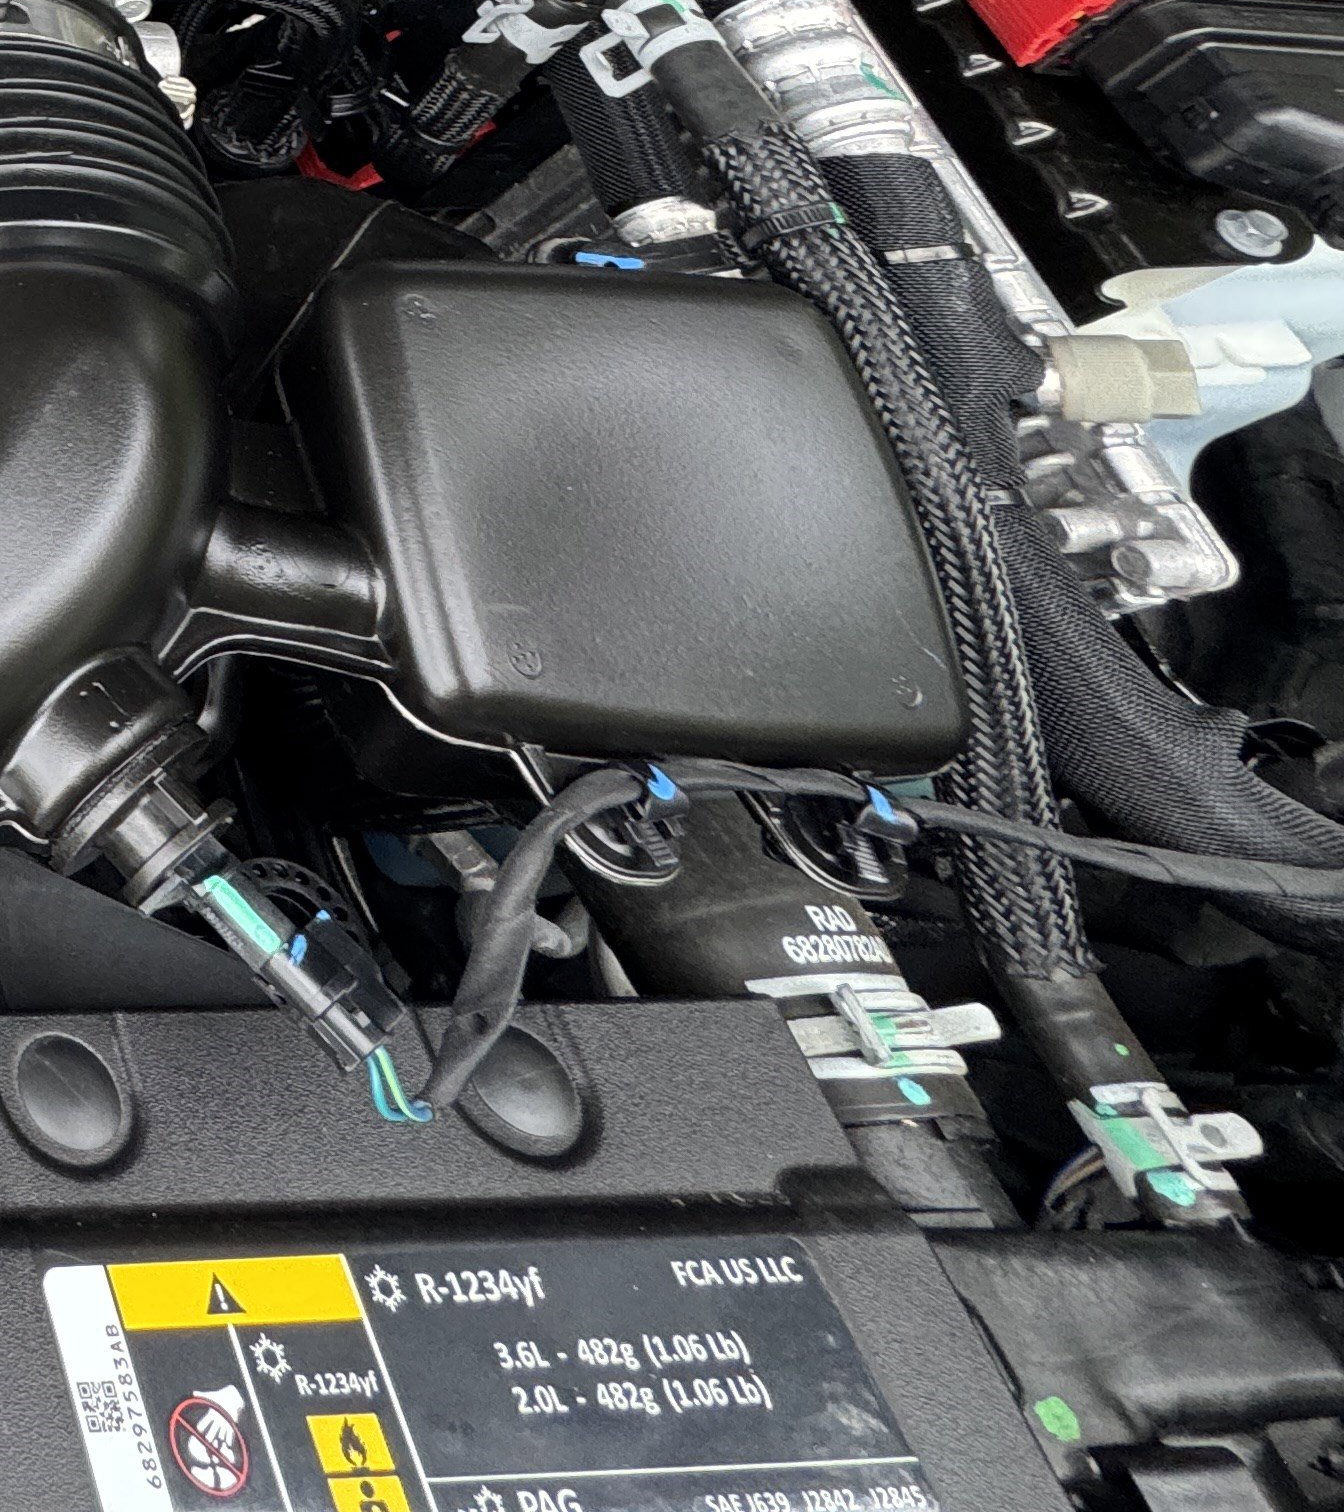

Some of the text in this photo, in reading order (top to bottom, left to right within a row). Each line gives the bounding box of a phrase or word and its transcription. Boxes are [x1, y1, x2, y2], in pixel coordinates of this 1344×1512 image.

[804, 904, 858, 932] RAD
[414, 1267, 546, 1308] R-1234yf
[670, 1257, 804, 1287] FCA US LLC
[493, 1341, 551, 1370] 3.6L
[577, 1338, 641, 1371] 482g
[642, 1333, 709, 1369] (1.06
[706, 1330, 751, 1365] Lb)
[295, 1370, 379, 1397] R-1234yf
[511, 1384, 570, 1414] 2.0L
[596, 1382, 661, 1416] 482g
[662, 1377, 729, 1413] (1.06
[727, 1374, 773, 1410] Lb)
[105, 1324, 162, 1490] 68297583AB
[516, 1488, 584, 1512] PAG
